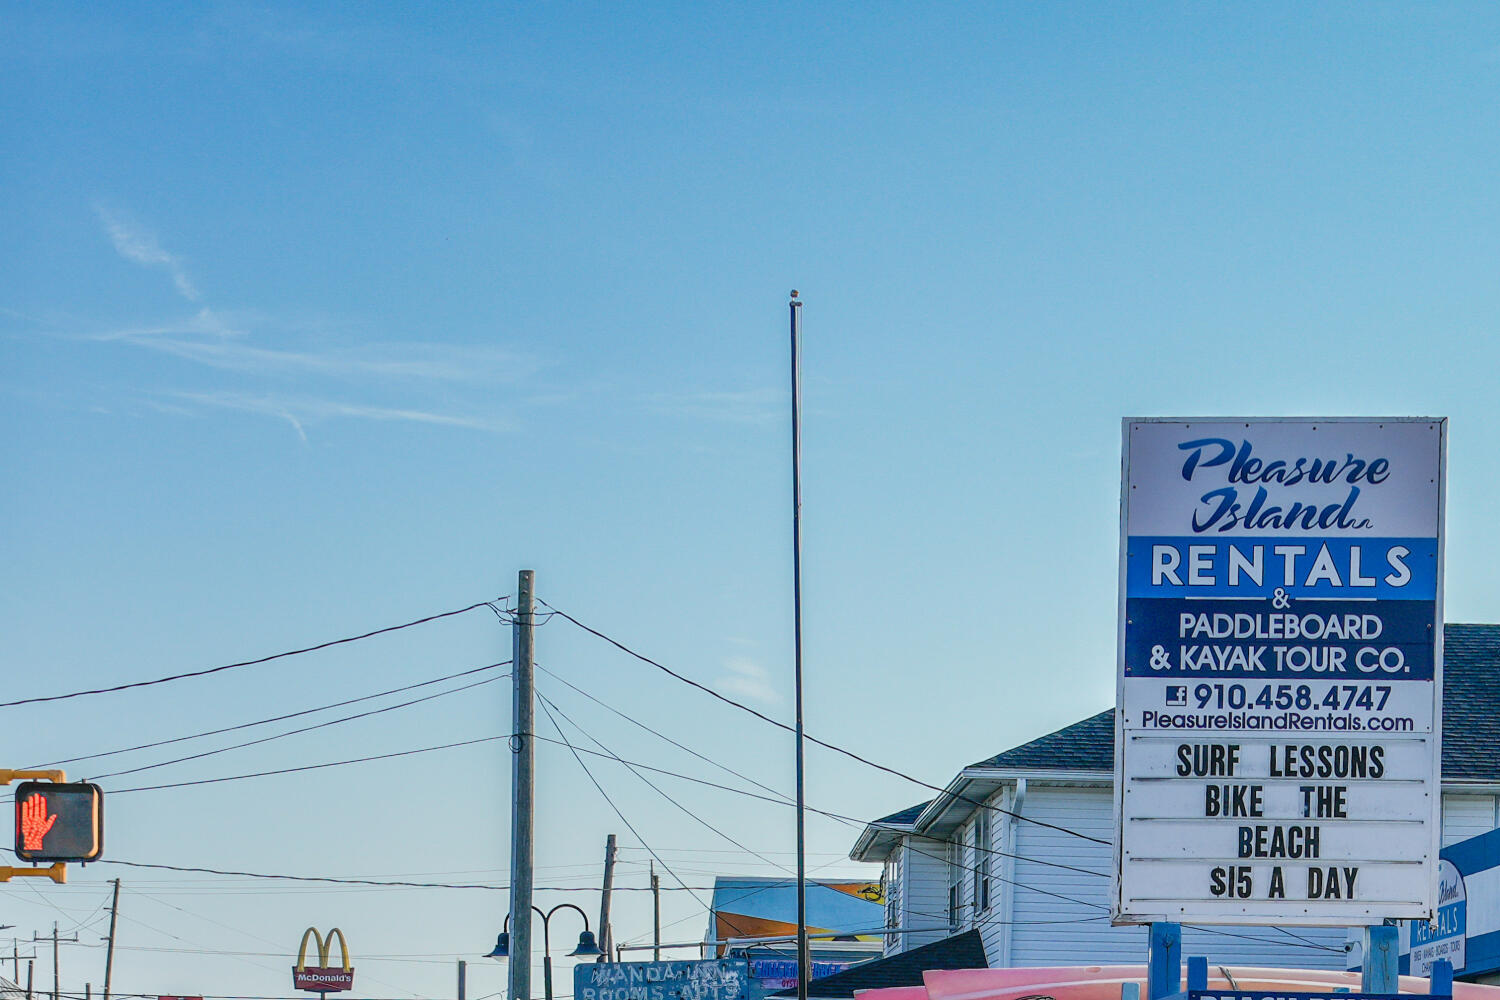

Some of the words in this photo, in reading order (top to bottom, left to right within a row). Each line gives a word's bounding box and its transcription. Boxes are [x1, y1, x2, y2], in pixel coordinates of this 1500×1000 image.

[1178, 438, 1390, 486] Pleasure
[1192, 486, 1362, 533] Island
[1152, 541, 1412, 587] RENTALS
[1272, 588, 1291, 609] &
[1180, 613, 1383, 640] PADDLEBOARD
[1150, 645, 1171, 671] &
[1180, 646, 1267, 671] KAYAK
[1273, 646, 1347, 672] TOUR
[1355, 647, 1411, 673] CO.
[1194, 684, 1392, 711] 910.458.4747
[1142, 710, 1414, 732] PleasureIslandRentals.com
[1176, 744, 1240, 777] SURF
[1269, 745, 1385, 778] LESSONS
[1205, 785, 1263, 817] BIKE
[1300, 786, 1348, 818] THE
[1238, 826, 1320, 858] BEACH
[1210, 866, 1253, 899] $15
[1268, 866, 1285, 899] A
[1307, 867, 1360, 899] DAY
[298, 974, 352, 982] McDonald's
